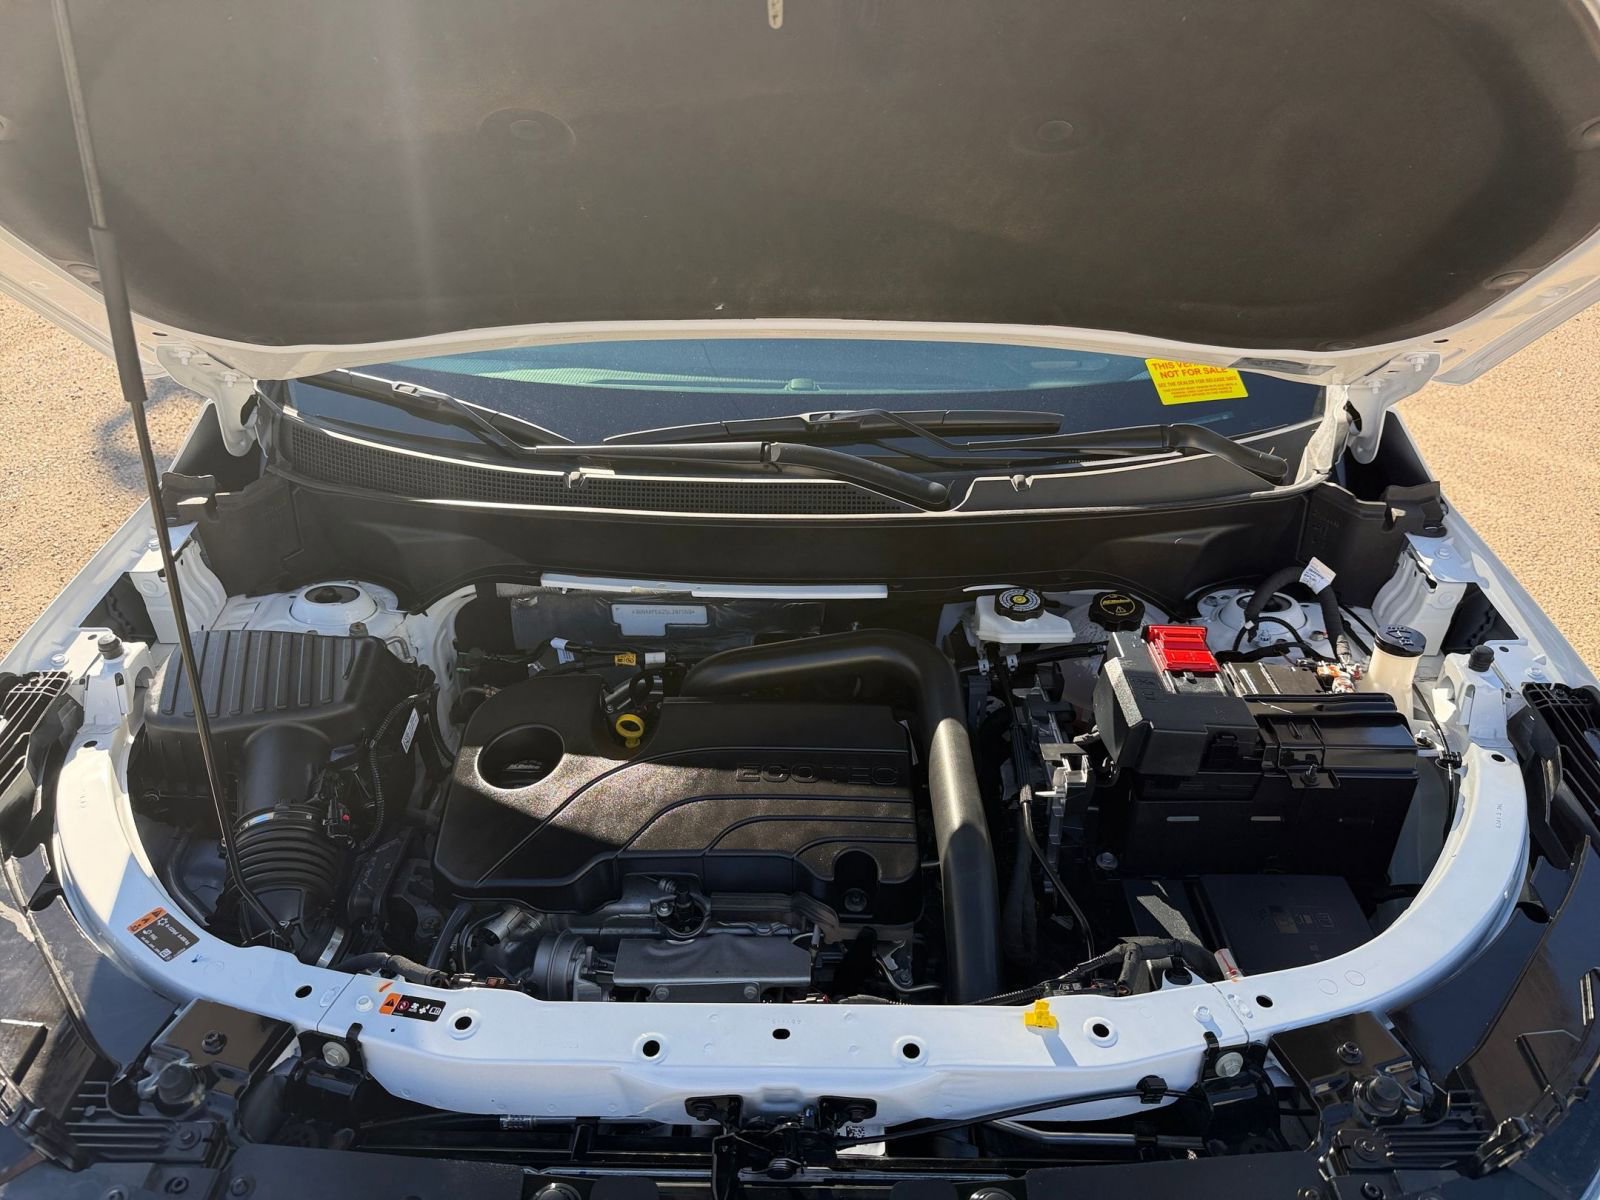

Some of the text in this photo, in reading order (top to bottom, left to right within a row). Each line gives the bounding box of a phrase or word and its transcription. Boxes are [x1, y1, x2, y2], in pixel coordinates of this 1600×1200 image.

[1152, 361, 1175, 370] THIS
[1160, 370, 1179, 379] NOT
[1182, 368, 1201, 377] FOR
